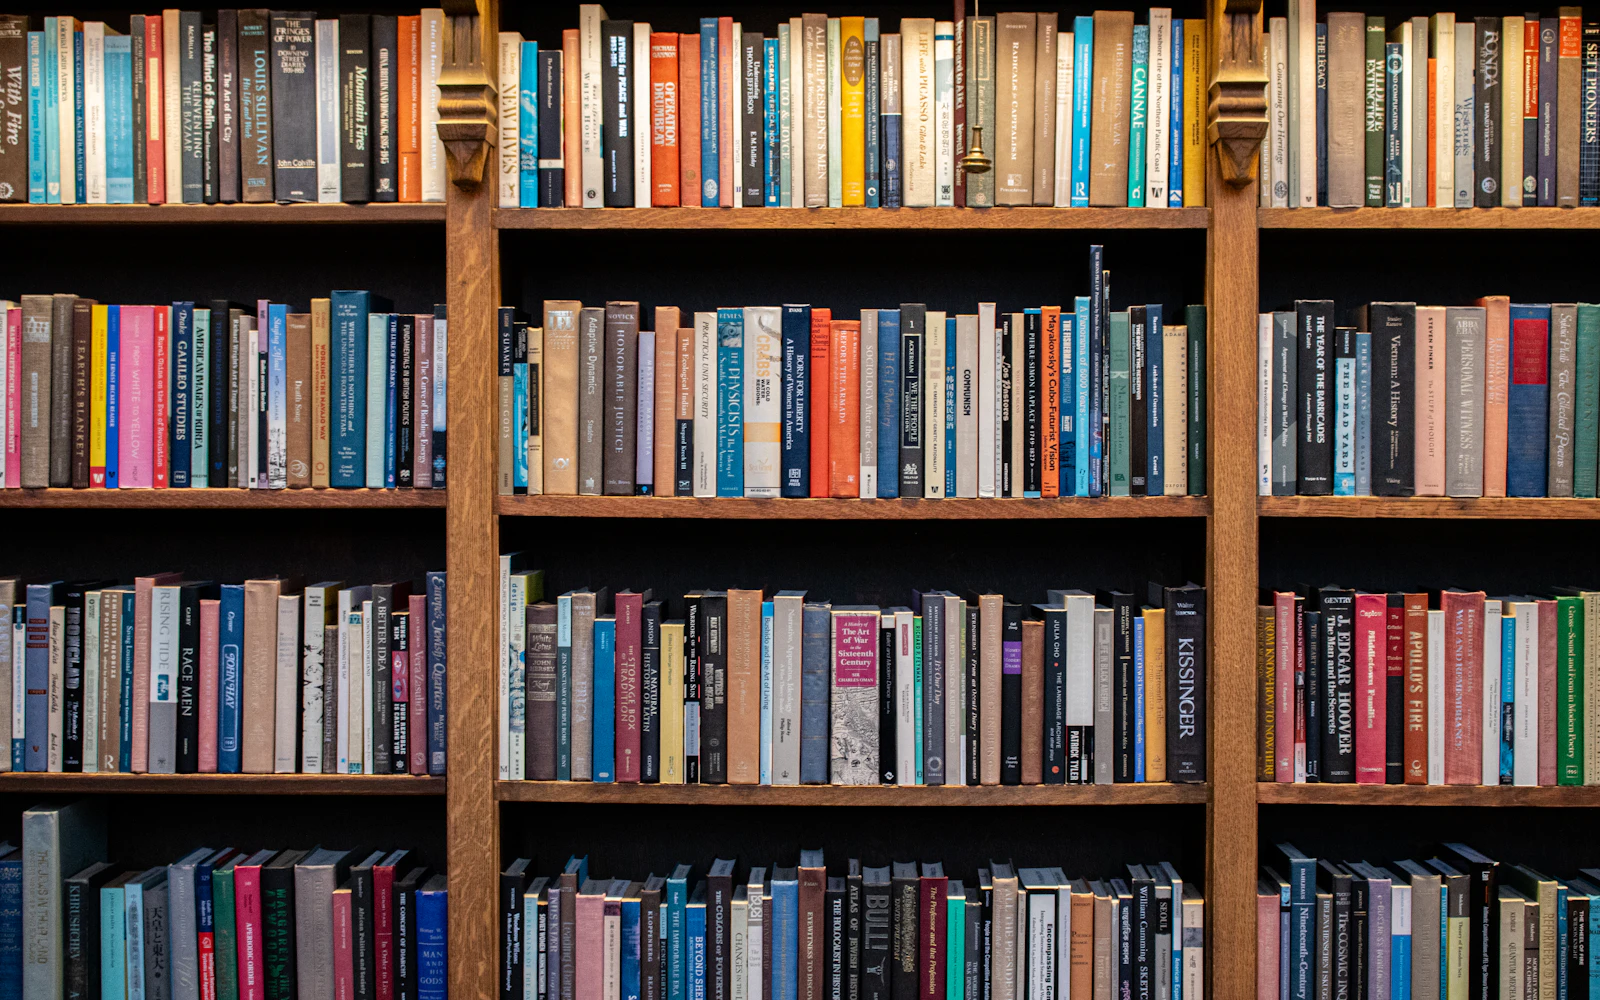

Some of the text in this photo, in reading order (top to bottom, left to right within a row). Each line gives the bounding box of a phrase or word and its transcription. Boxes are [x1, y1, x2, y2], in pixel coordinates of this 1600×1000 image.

[60, 20, 69, 102] Colonial Latin America
[1155, 25, 1164, 56] Seashore
[1155, 58, 1163, 74] Life
[1317, 55, 1326, 89] LEGACY
[7, 66, 22, 145] With Fire
[204, 32, 214, 130] The Mind of Stalin
[255, 50, 268, 166] LOUIS SULLIVAN
[354, 65, 368, 151] Mountain Fires
[816, 26, 826, 179] ALL THE PRESIDENT'S MEN
[1132, 68, 1145, 128] CANNAE
[1154, 95, 1162, 126] Northern
[1275, 62, 1284, 108] Concerning
[1586, 43, 1597, 143] SETI PIONEERS
[183, 85, 192, 152] THE BAZAAR
[192, 81, 202, 159] REINVENTING
[502, 83, 517, 174] NEW LIVES
[654, 82, 664, 145] DRUMBEAT
[664, 82, 676, 146] OPERATION
[1154, 129, 1162, 151] Pacific
[1276, 130, 1285, 165] Heritage
[176, 309, 187, 441] Drake GALILEO STUDIES
[588, 317, 597, 395] Adaptive Dynamics
[681, 354, 689, 390] Ecological
[756, 335, 770, 377] CRABS
[796, 355, 804, 378] BORN
[1388, 335, 1400, 427] Vietnam: A History
[76, 346, 86, 457] EARTH'S BLANKET
[293, 380, 302, 423] Death Song
[402, 378, 410, 399] BRITISH
[613, 329, 625, 454] HONORABLE JUSTICE
[796, 398, 804, 433] LIBERTY
[963, 369, 971, 416] COMMUNISM
[1047, 315, 1057, 471] Mayakovsky's Cubo-Futurist Vision
[159, 590, 170, 669] RISING TIDE
[377, 596, 387, 672] A BETTER IDEA
[181, 647, 194, 716] RACE MEN
[643, 653, 651, 691] HISTORY
[840, 659, 871, 667] Century
[1178, 638, 1194, 739] KISSINGER
[1337, 615, 1351, 755] J. EDGAR HOOVER
[1409, 631, 1423, 732] APOLLO'S FIRE
[643, 693, 650, 705] OF
[1070, 731, 1079, 780] PATRICK TYLER
[69, 885, 81, 961] KHRUSHCHEV
[400, 938, 406, 947] OF
[865, 894, 889, 950] BULL!
[1138, 886, 1148, 962] William Cumming
[1297, 907, 1309, 999] Nineteenth-Century
[1579, 944, 1584, 952] OF
[245, 923, 254, 985] APERIODIC ORDER
[695, 936, 703, 976] BEYOND
[929, 960, 937, 994] Profession
